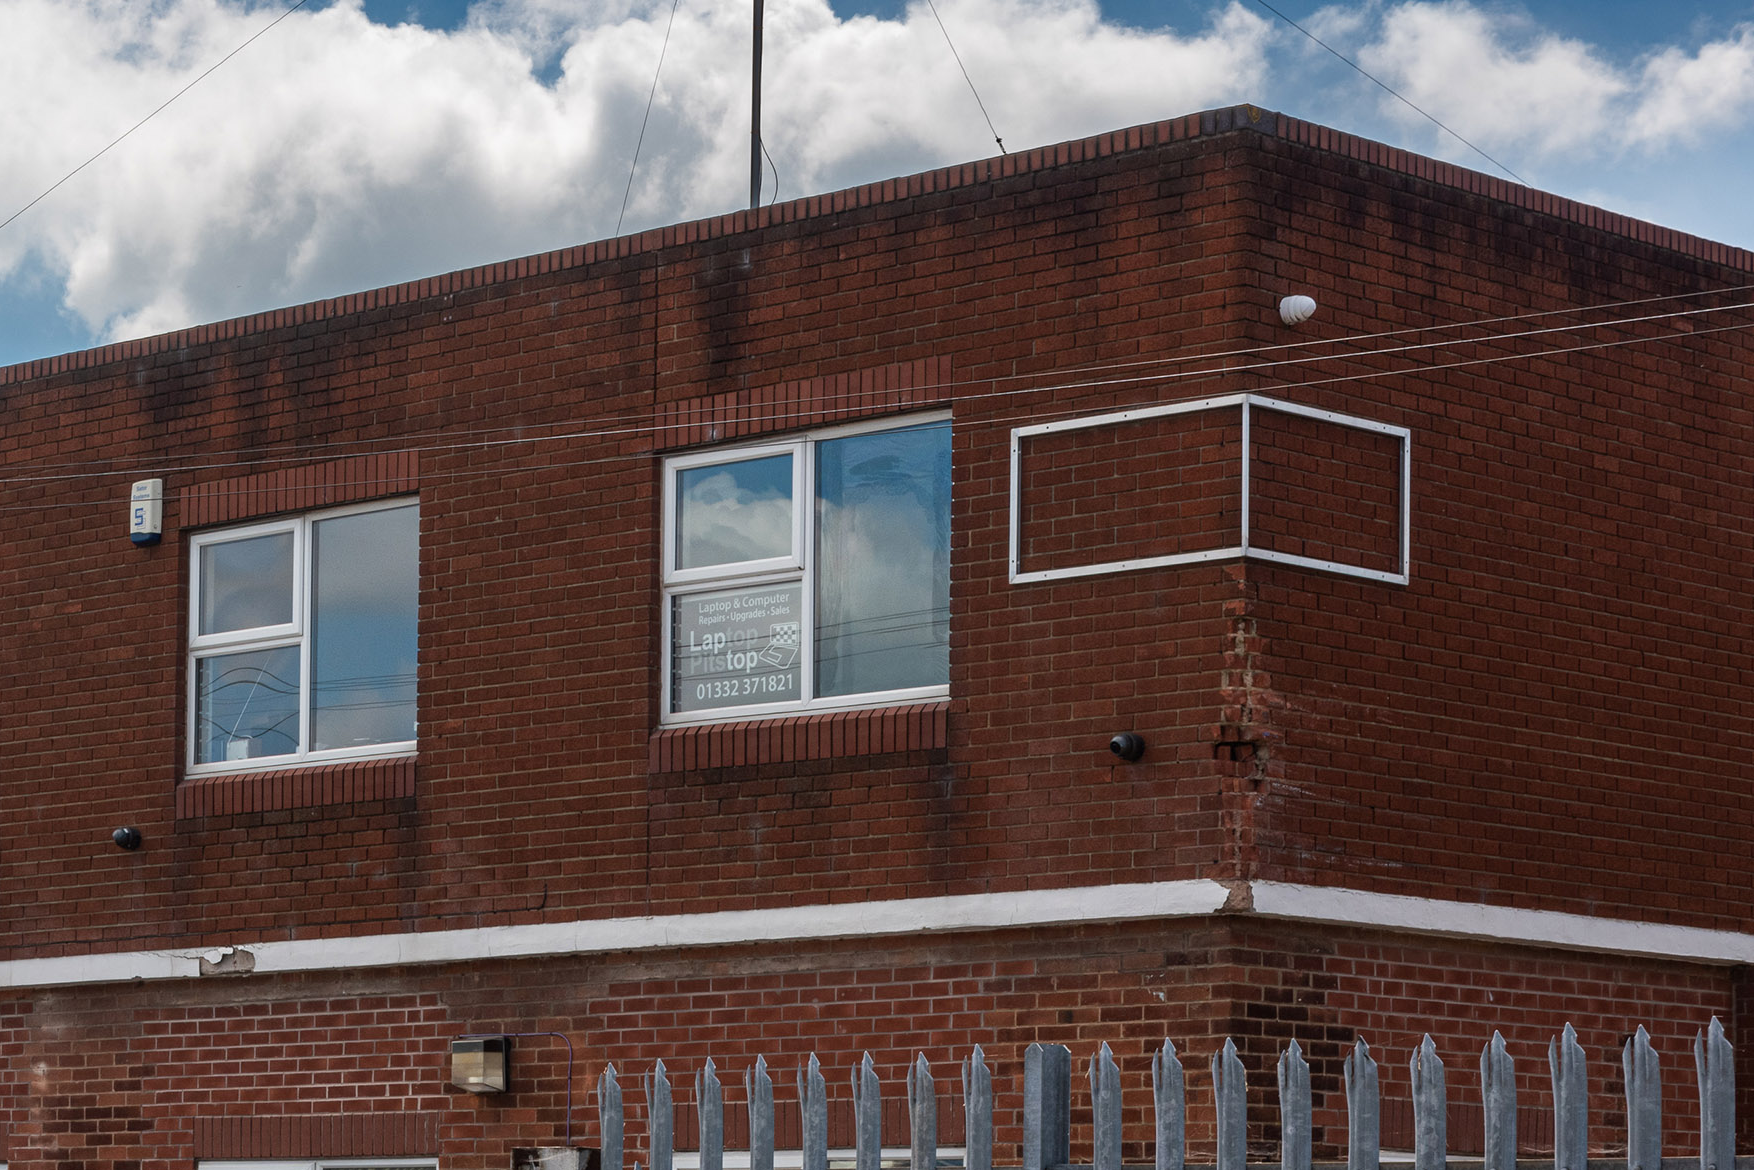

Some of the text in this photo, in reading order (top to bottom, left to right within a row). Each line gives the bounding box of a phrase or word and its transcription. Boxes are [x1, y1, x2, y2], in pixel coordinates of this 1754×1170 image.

[699, 593, 790, 614] Laptop & Computer
[698, 605, 790, 626] Repairs Upgrades Sales
[697, 673, 793, 700] 01332 371821
